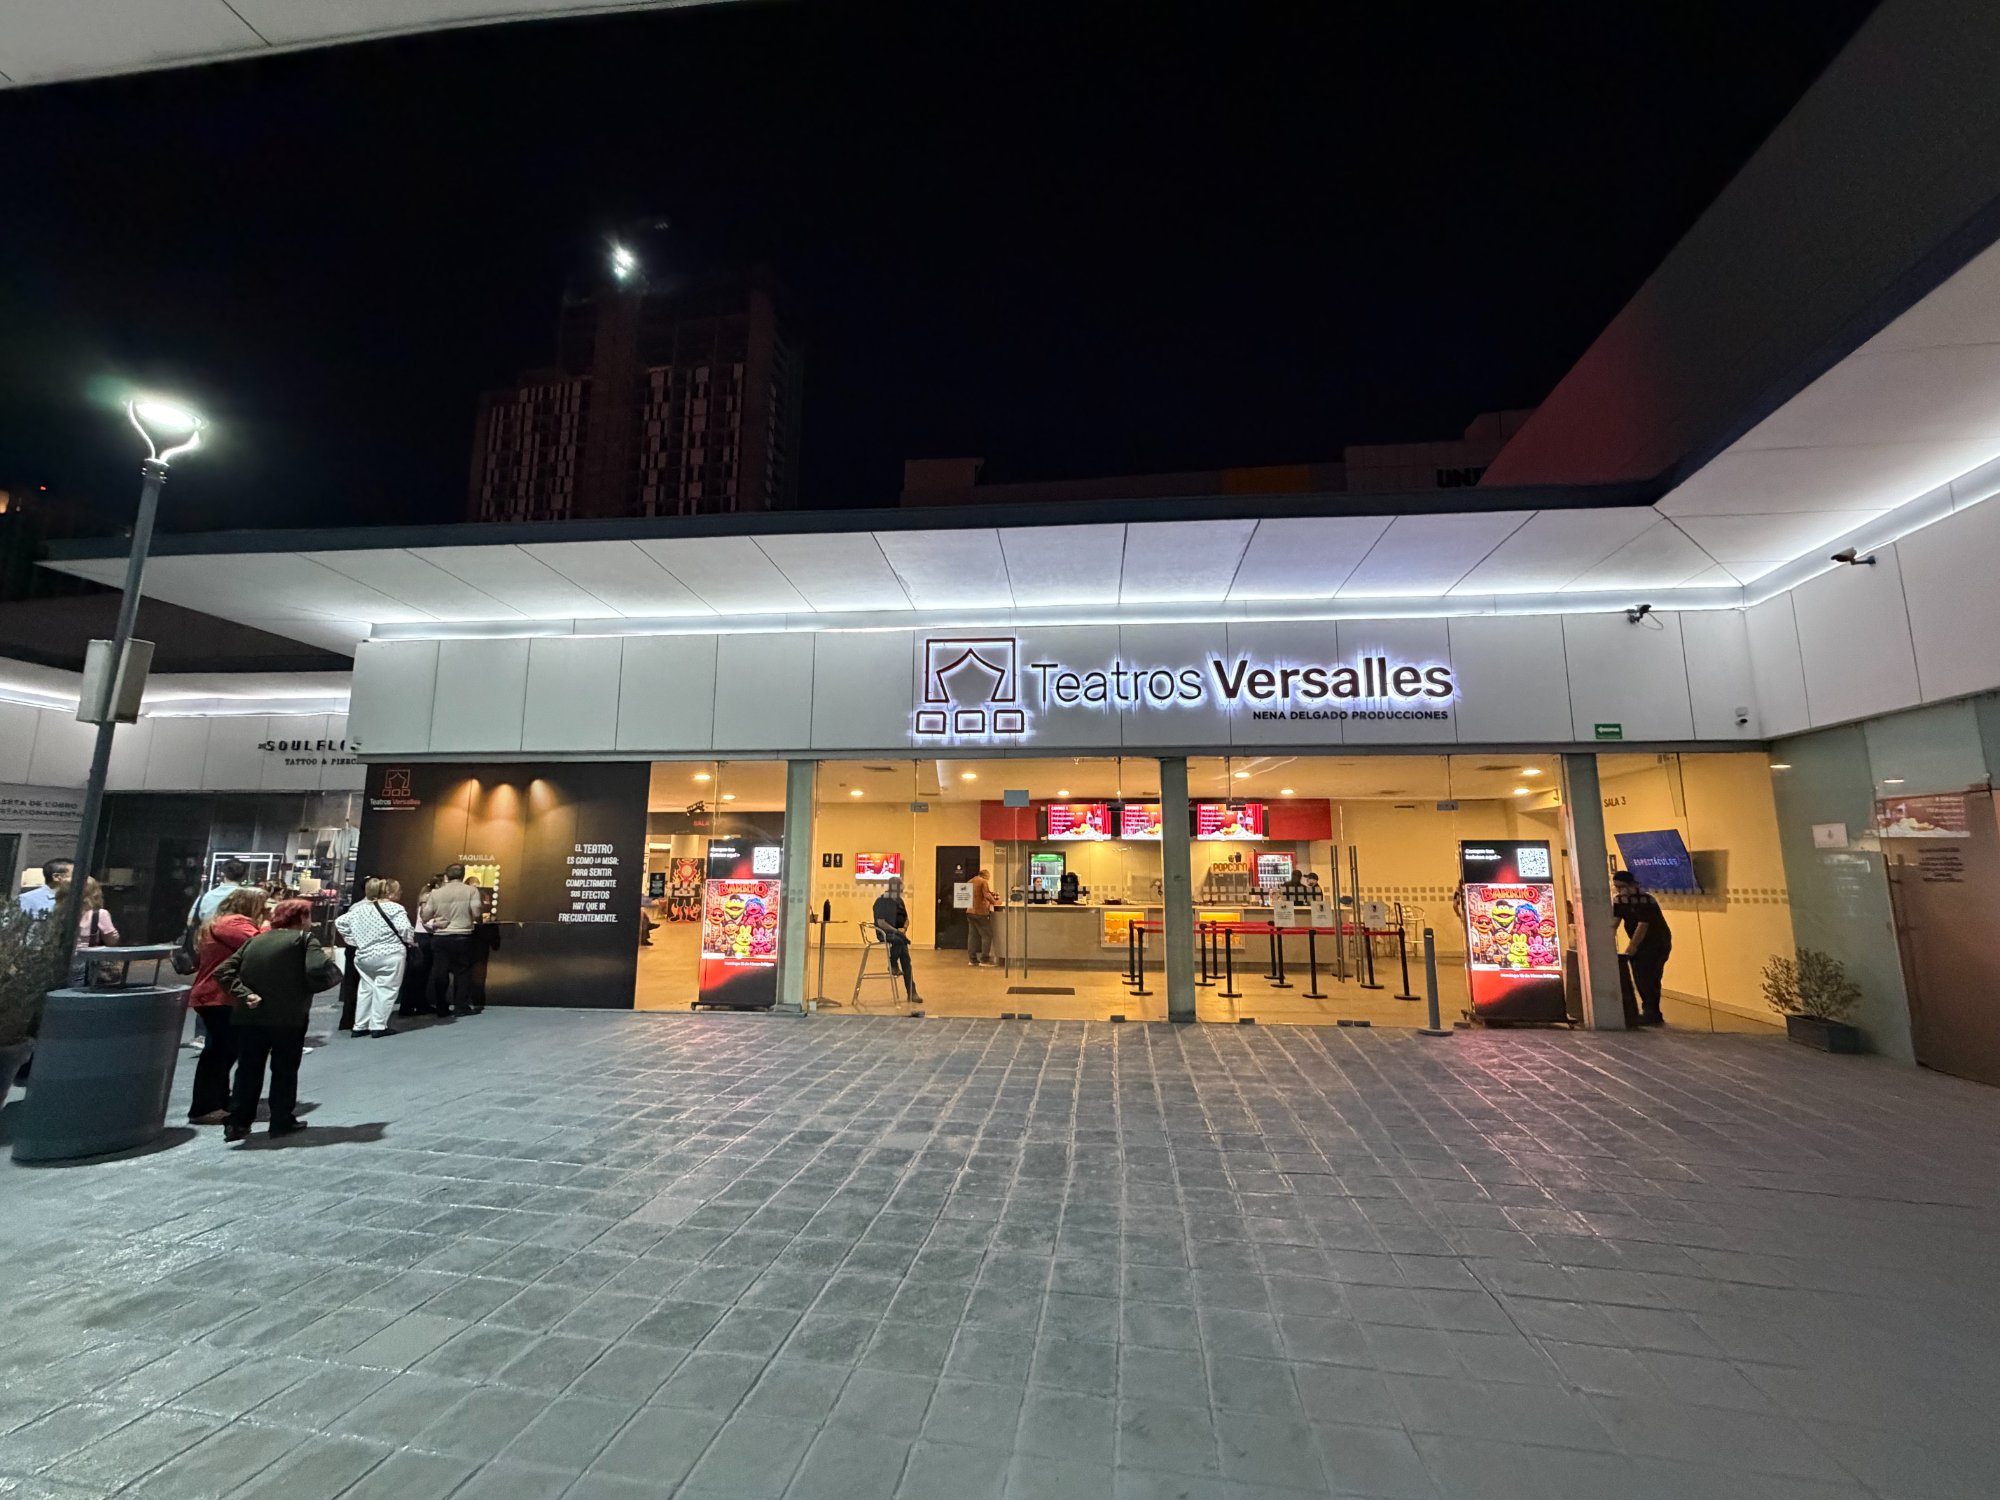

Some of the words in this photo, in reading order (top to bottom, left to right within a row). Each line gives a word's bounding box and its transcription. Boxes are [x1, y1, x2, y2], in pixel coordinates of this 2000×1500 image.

[1031, 661, 1202, 702] Teatros
[1213, 656, 1453, 699] Versalles
[1252, 710, 1287, 721] NENA
[1289, 710, 1349, 721] DELGADO
[1351, 710, 1449, 721] PRODUCCIONES
[284, 758, 318, 766] TATTOO
[1603, 797, 1620, 808] SALA
[1621, 796, 1626, 805] 3
[583, 844, 613, 854] TEATRO
[589, 868, 612, 876] SENTIR
[566, 879, 616, 887] COMPLETAMENTE
[582, 891, 610, 899] EFECTOS
[573, 902, 585, 910] HAY
[586, 902, 598, 911] QUE
[599, 902, 606, 910] IR
